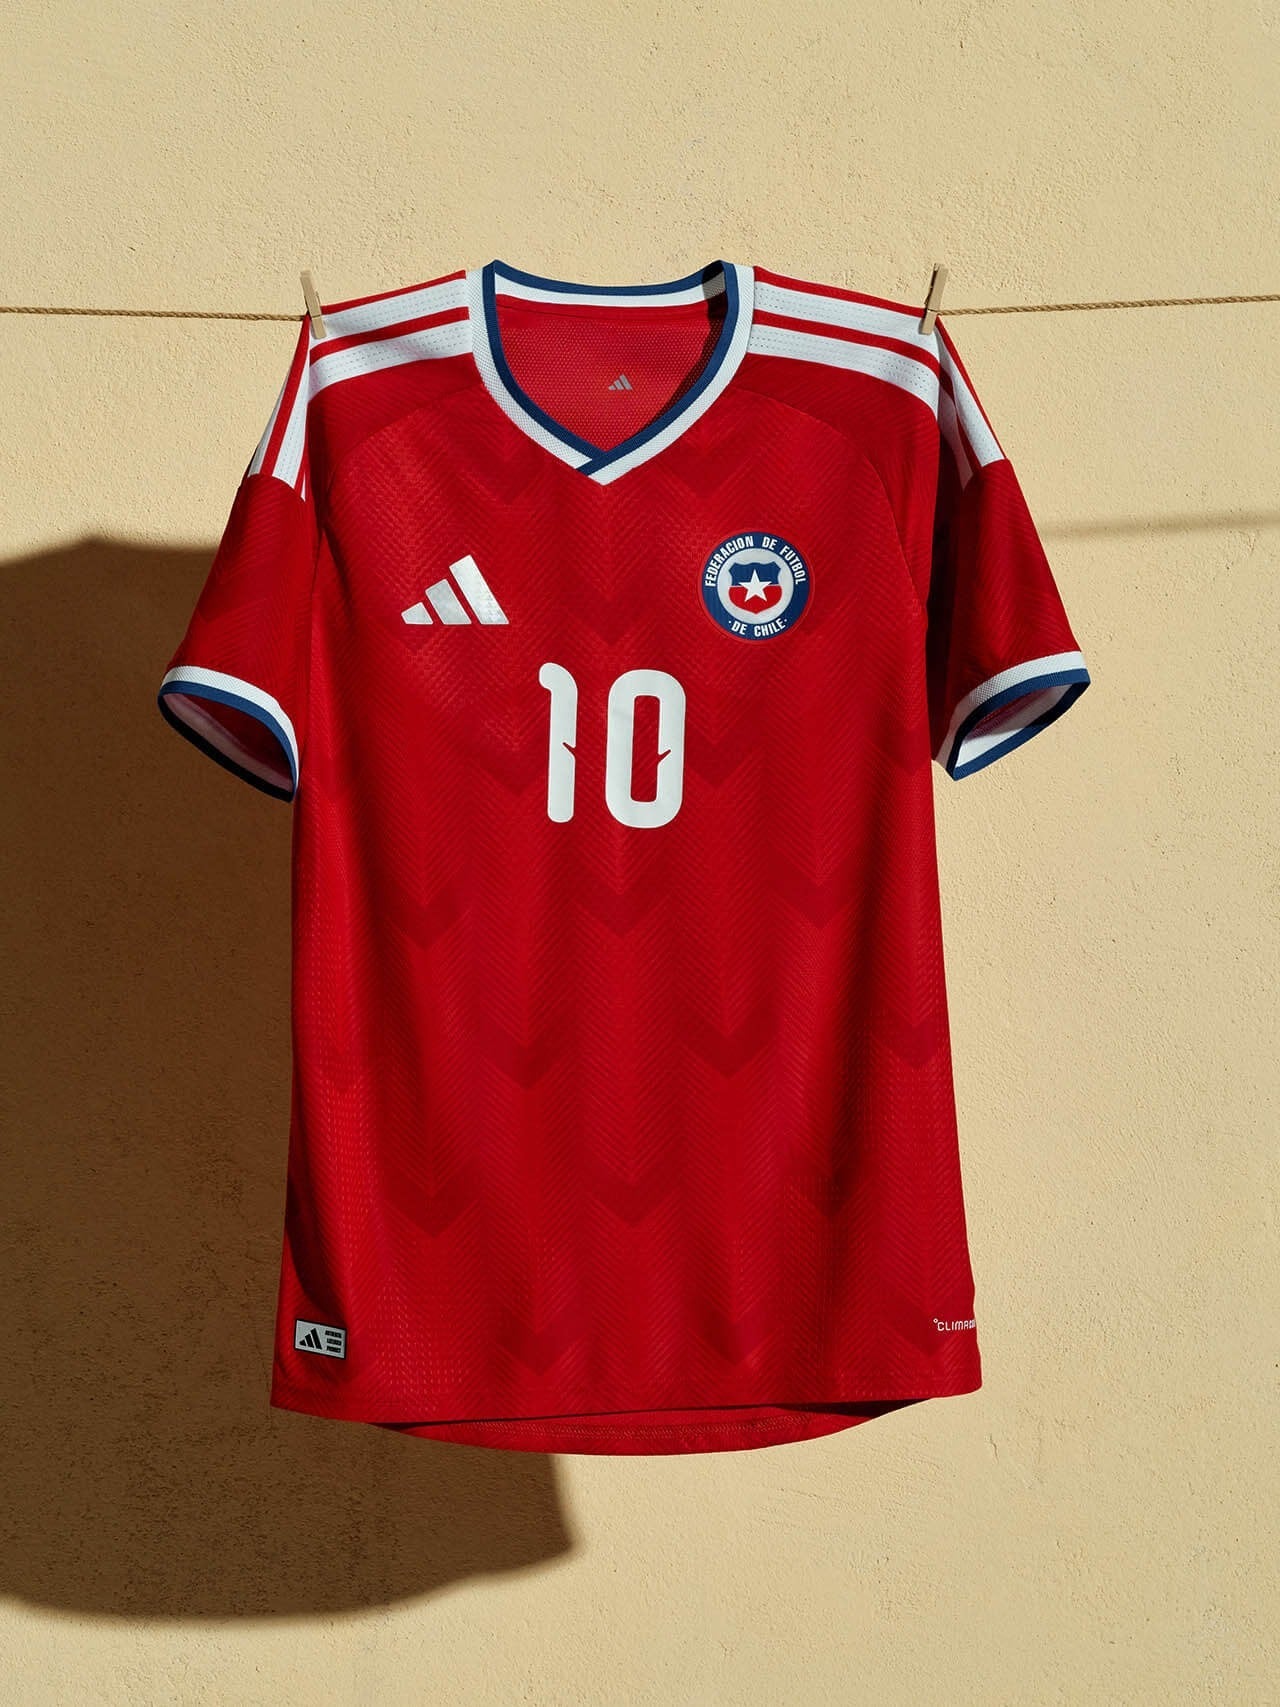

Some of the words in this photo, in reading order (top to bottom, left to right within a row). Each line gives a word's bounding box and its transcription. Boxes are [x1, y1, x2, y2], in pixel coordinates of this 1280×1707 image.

[705, 536, 754, 587] FEDERACION
[762, 536, 778, 550] DE
[779, 545, 806, 585] FUTBOL
[538, 662, 686, 829] 10
